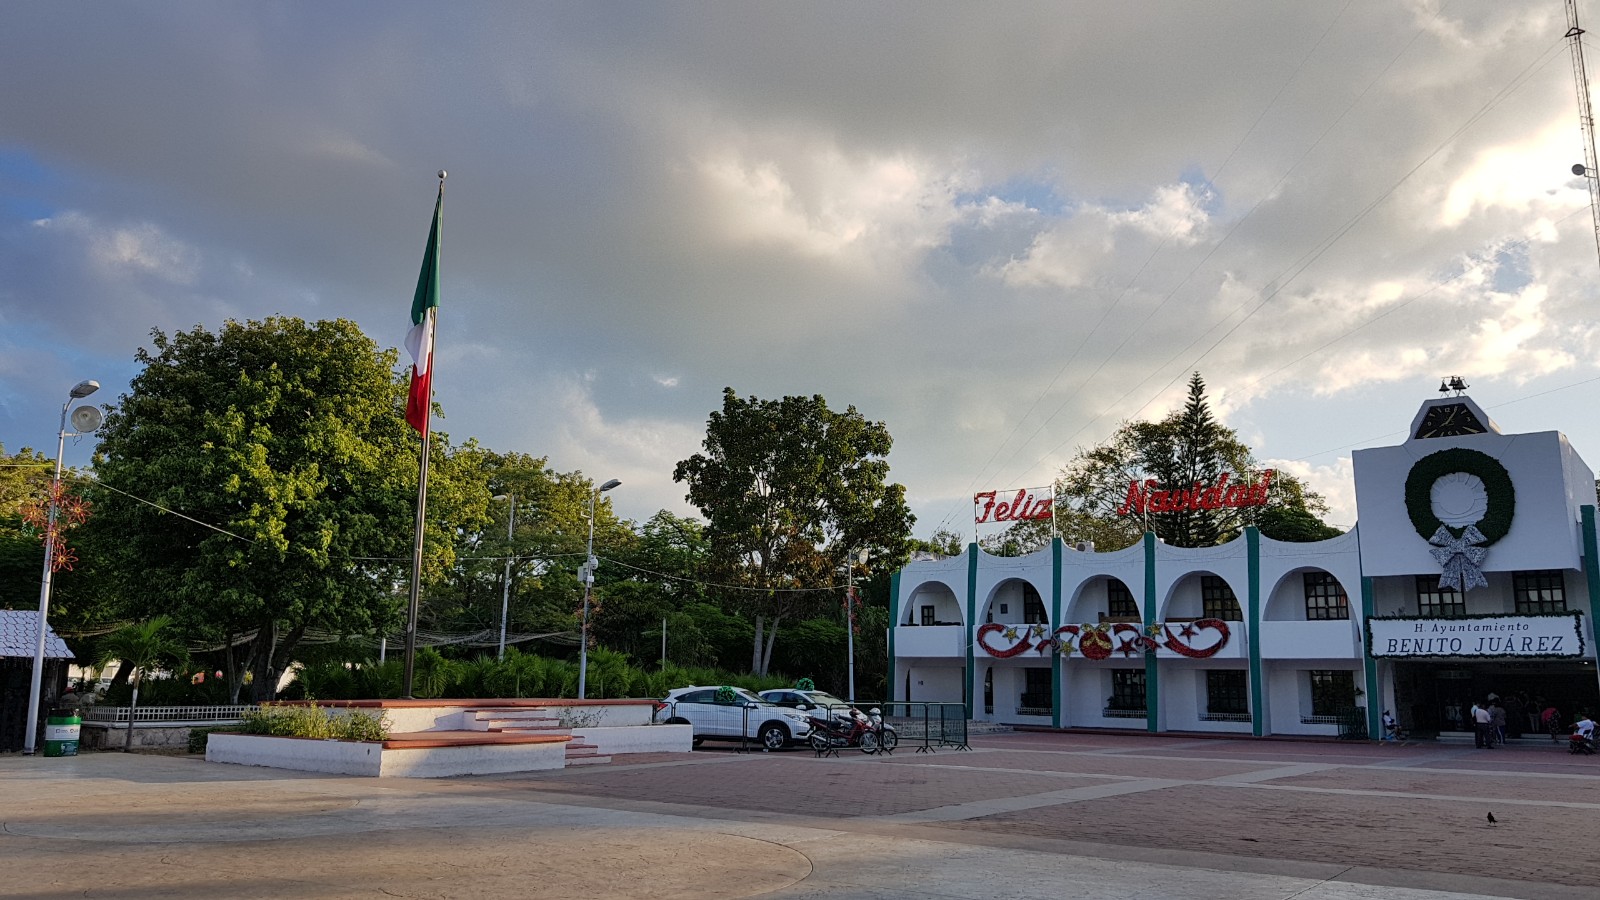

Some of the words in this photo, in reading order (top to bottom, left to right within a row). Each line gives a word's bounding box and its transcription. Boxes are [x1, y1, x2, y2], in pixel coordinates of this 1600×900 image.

[974, 488, 1053, 523] Feliz
[1117, 468, 1273, 515] Navidad
[1414, 623, 1427, 633] H.
[1432, 621, 1530, 635] Ayuntamiento
[1386, 637, 1463, 653] BENITO
[1474, 633, 1564, 653] JUÁREZ
